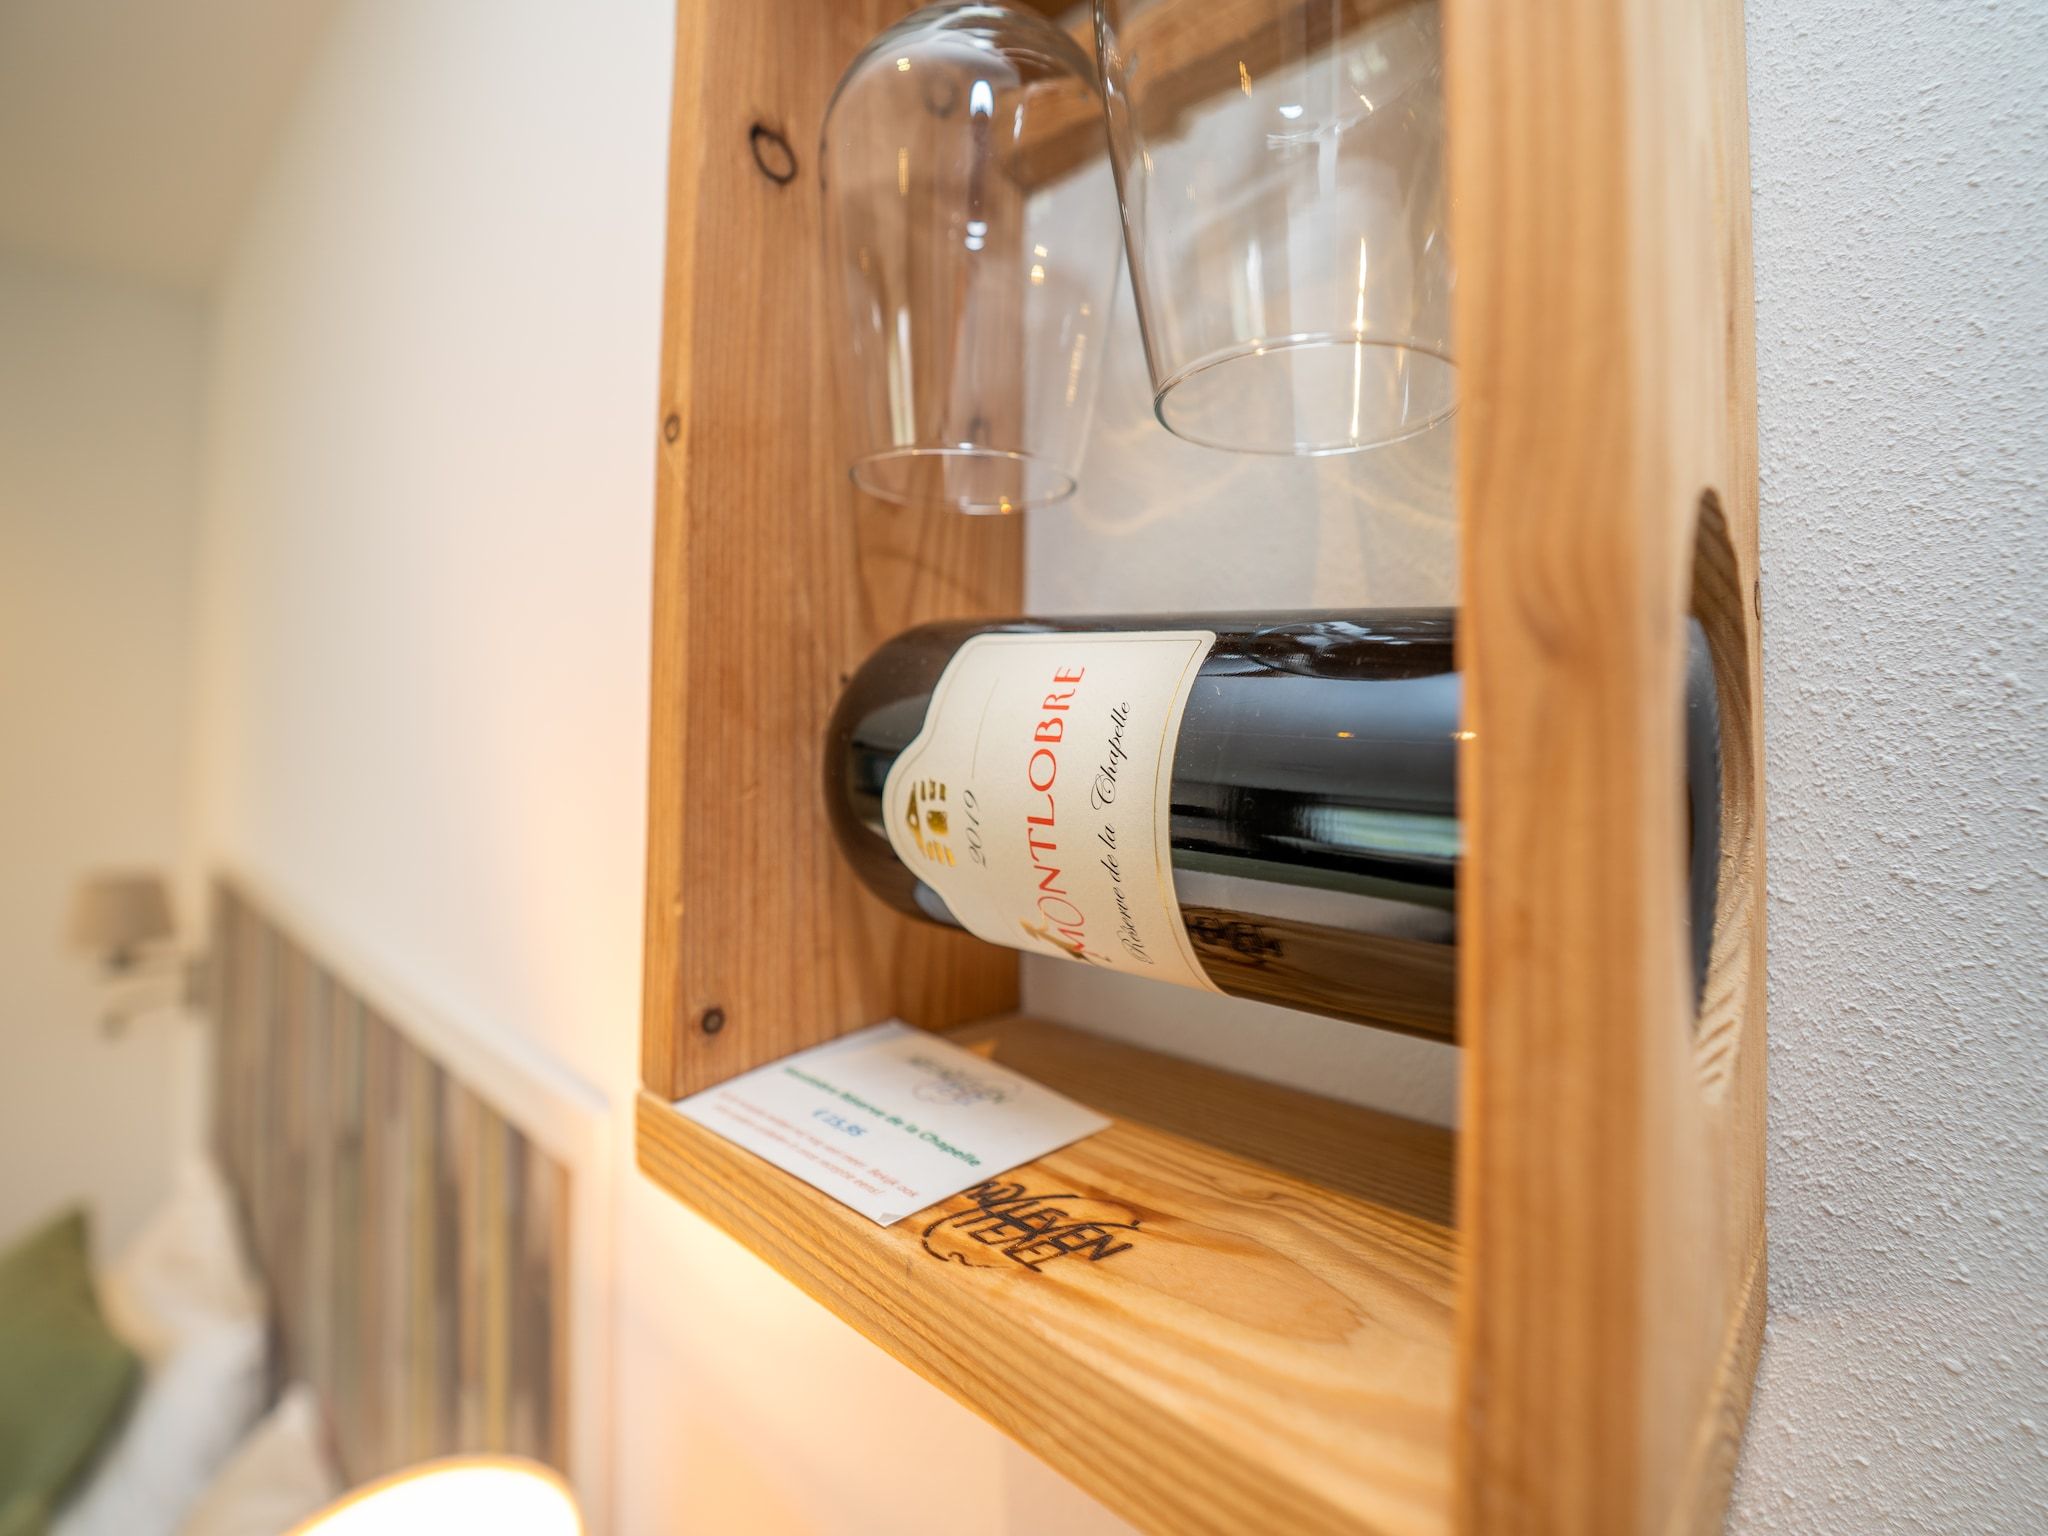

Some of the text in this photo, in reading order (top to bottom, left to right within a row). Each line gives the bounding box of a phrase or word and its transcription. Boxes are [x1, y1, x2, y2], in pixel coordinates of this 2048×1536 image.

[1091, 702, 1130, 811] Chapelle
[963, 789, 986, 868] 2019
[1027, 664, 1110, 962] MONTLOBRE
[1098, 823, 1116, 850] la
[1100, 854, 1121, 882] de
[919, 1131, 981, 1168] Chapelle
